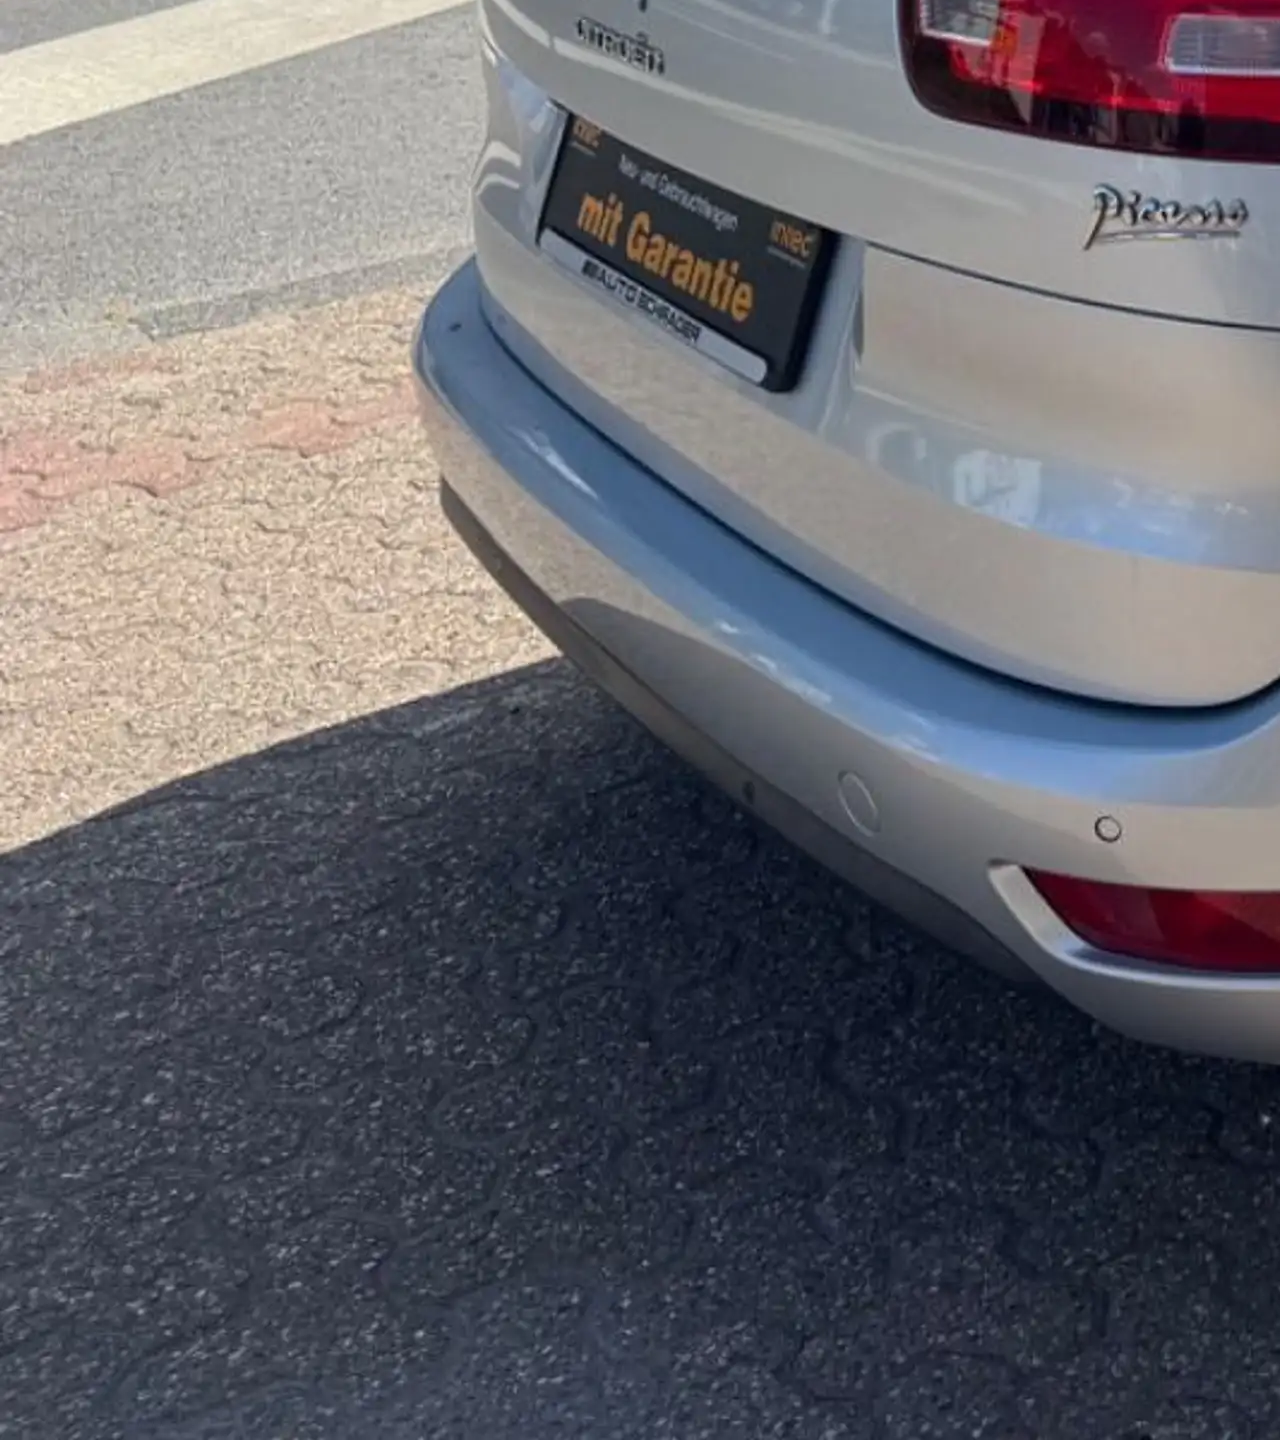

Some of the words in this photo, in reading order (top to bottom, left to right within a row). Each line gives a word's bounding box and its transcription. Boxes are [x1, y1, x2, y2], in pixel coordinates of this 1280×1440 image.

[576, 192, 623, 247] mit
[626, 210, 754, 323] Garantie
[597, 266, 637, 303] AUTO
